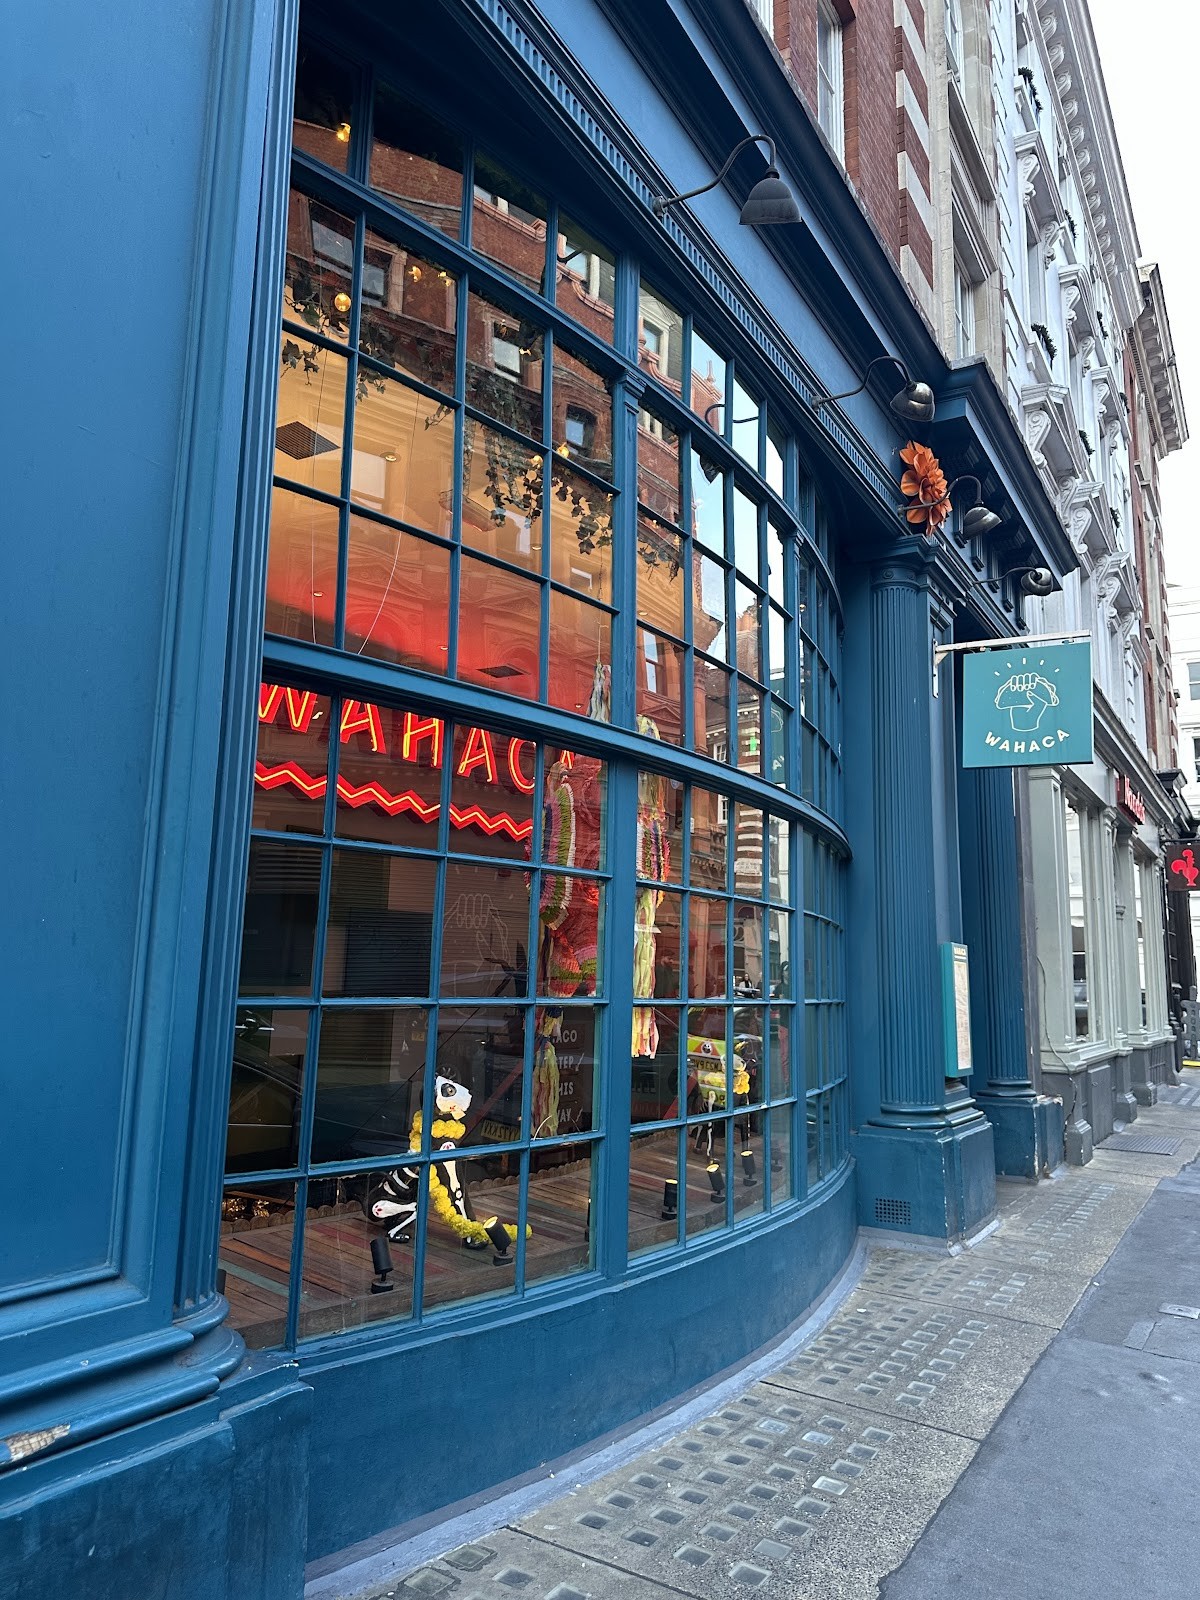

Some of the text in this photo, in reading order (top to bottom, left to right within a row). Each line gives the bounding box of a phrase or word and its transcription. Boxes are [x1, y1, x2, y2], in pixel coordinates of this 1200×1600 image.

[985, 729, 1070, 753] WAHACA
[552, 1030, 578, 1044] ACO
[557, 1056, 574, 1070] TEP
[558, 1082, 574, 1096] HIS
